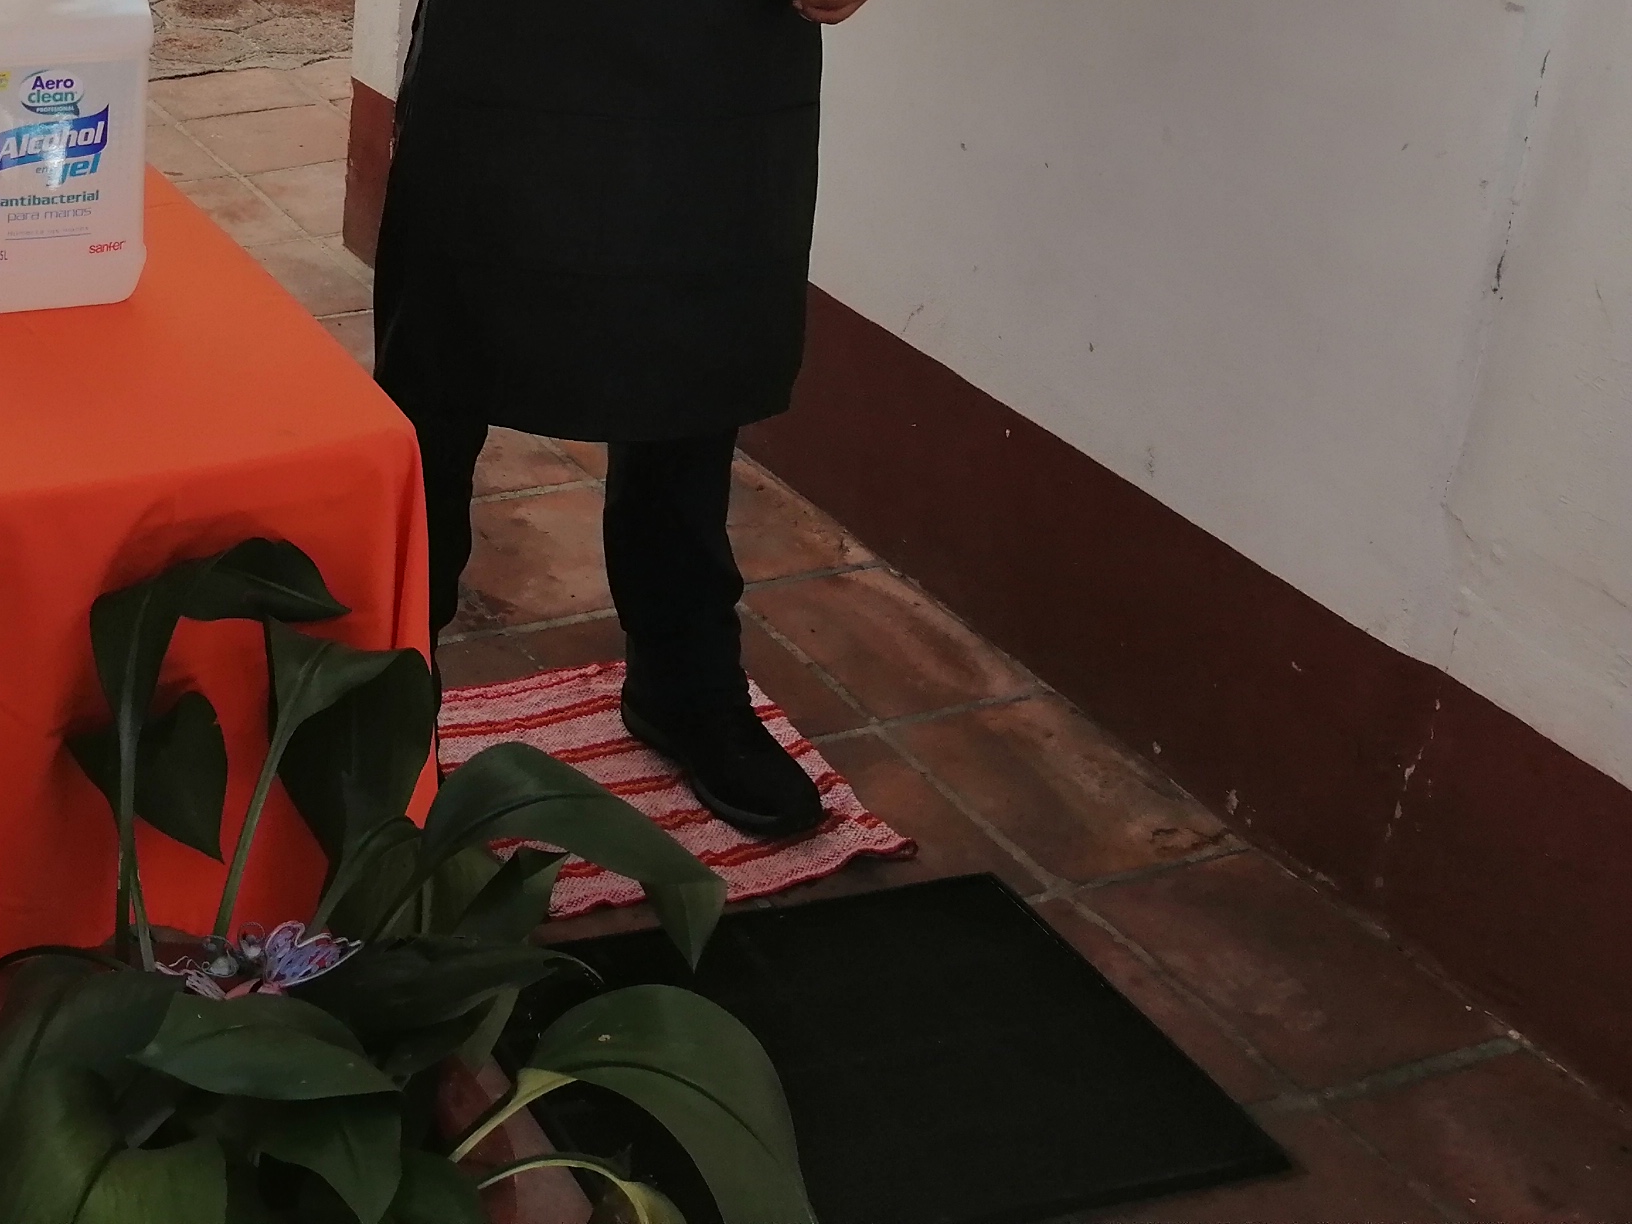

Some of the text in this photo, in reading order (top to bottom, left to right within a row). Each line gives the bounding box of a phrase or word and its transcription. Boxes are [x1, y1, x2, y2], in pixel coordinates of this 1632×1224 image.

[31, 76, 74, 90] Aero
[28, 90, 75, 104] clean
[35, 166, 47, 174] en
[0, 190, 99, 207] antibacterial
[7, 207, 92, 223] para manos
